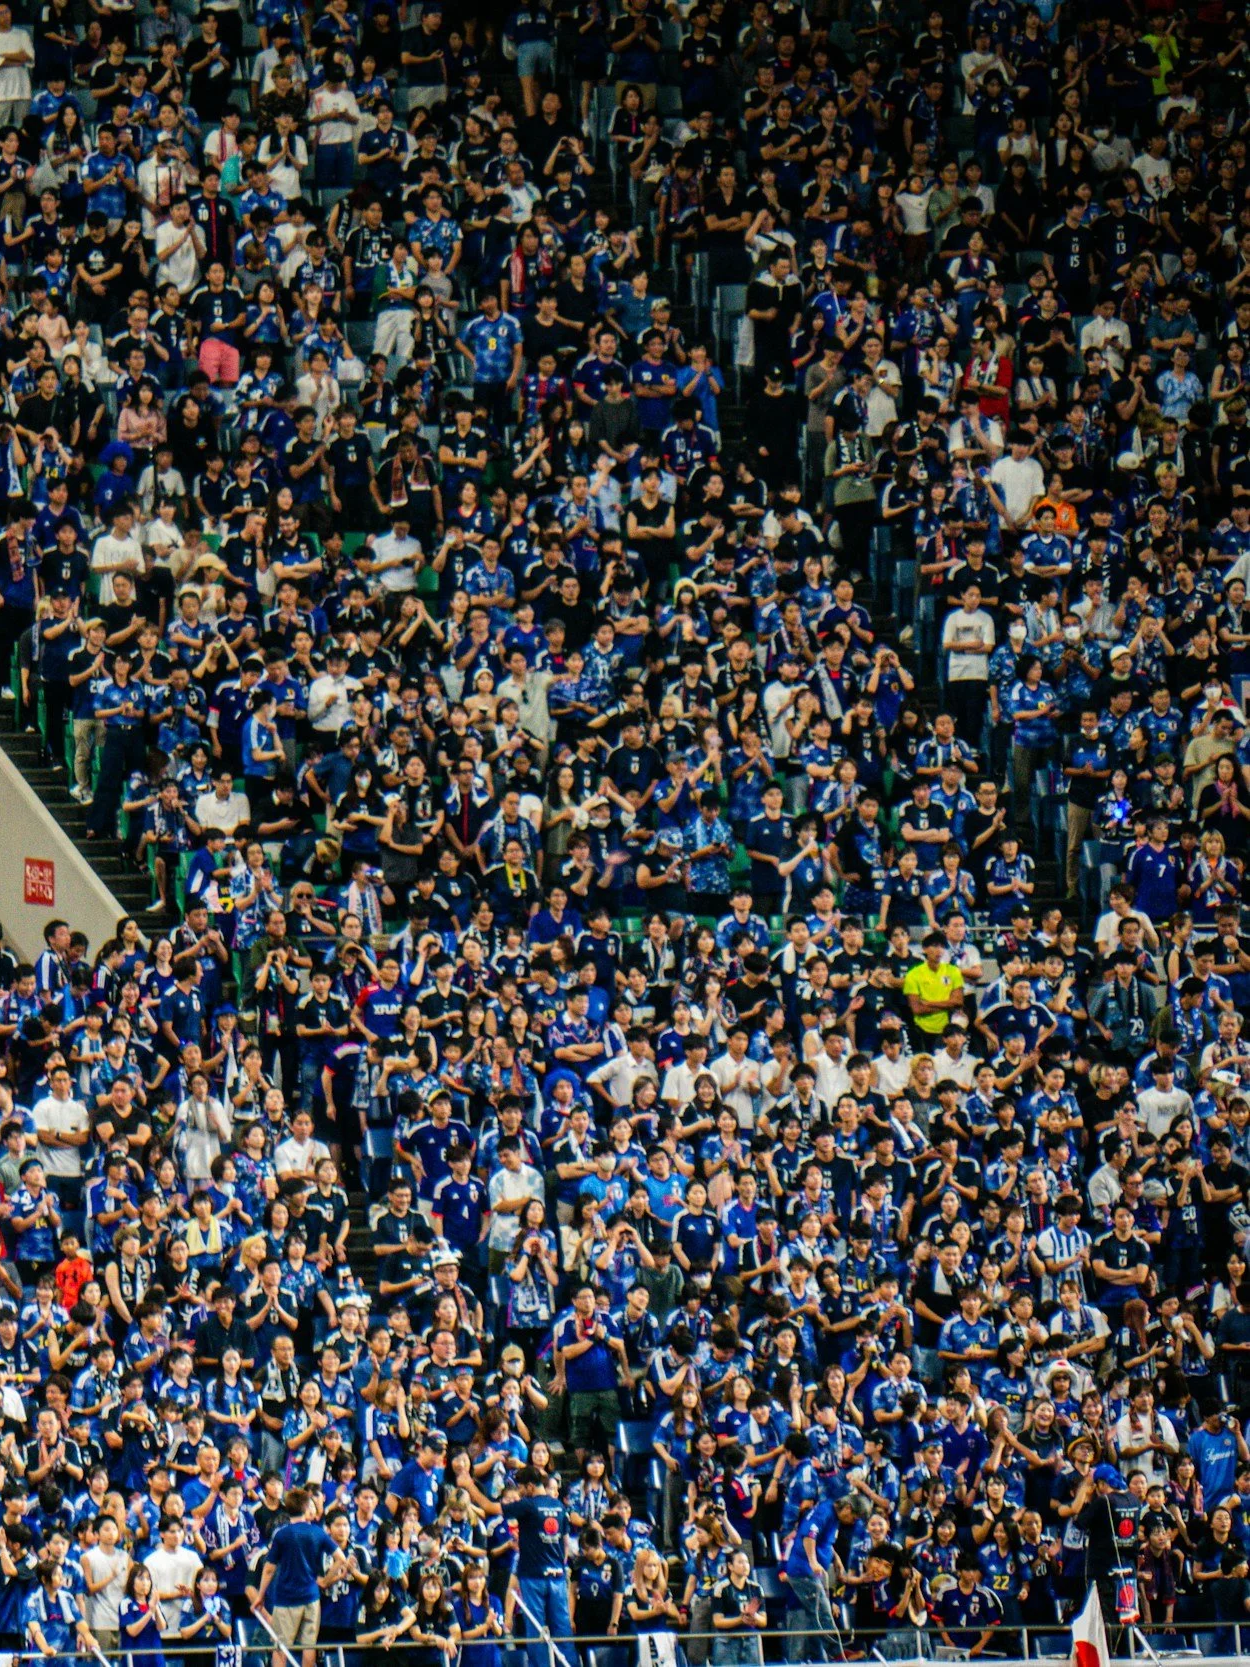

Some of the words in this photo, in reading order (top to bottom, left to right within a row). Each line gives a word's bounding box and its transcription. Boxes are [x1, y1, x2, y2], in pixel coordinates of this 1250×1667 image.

[511, 541, 527, 554] 12
[1158, 864, 1166, 877] 7
[1130, 1018, 1144, 1036] 29
[993, 1576, 1010, 1590] 22
